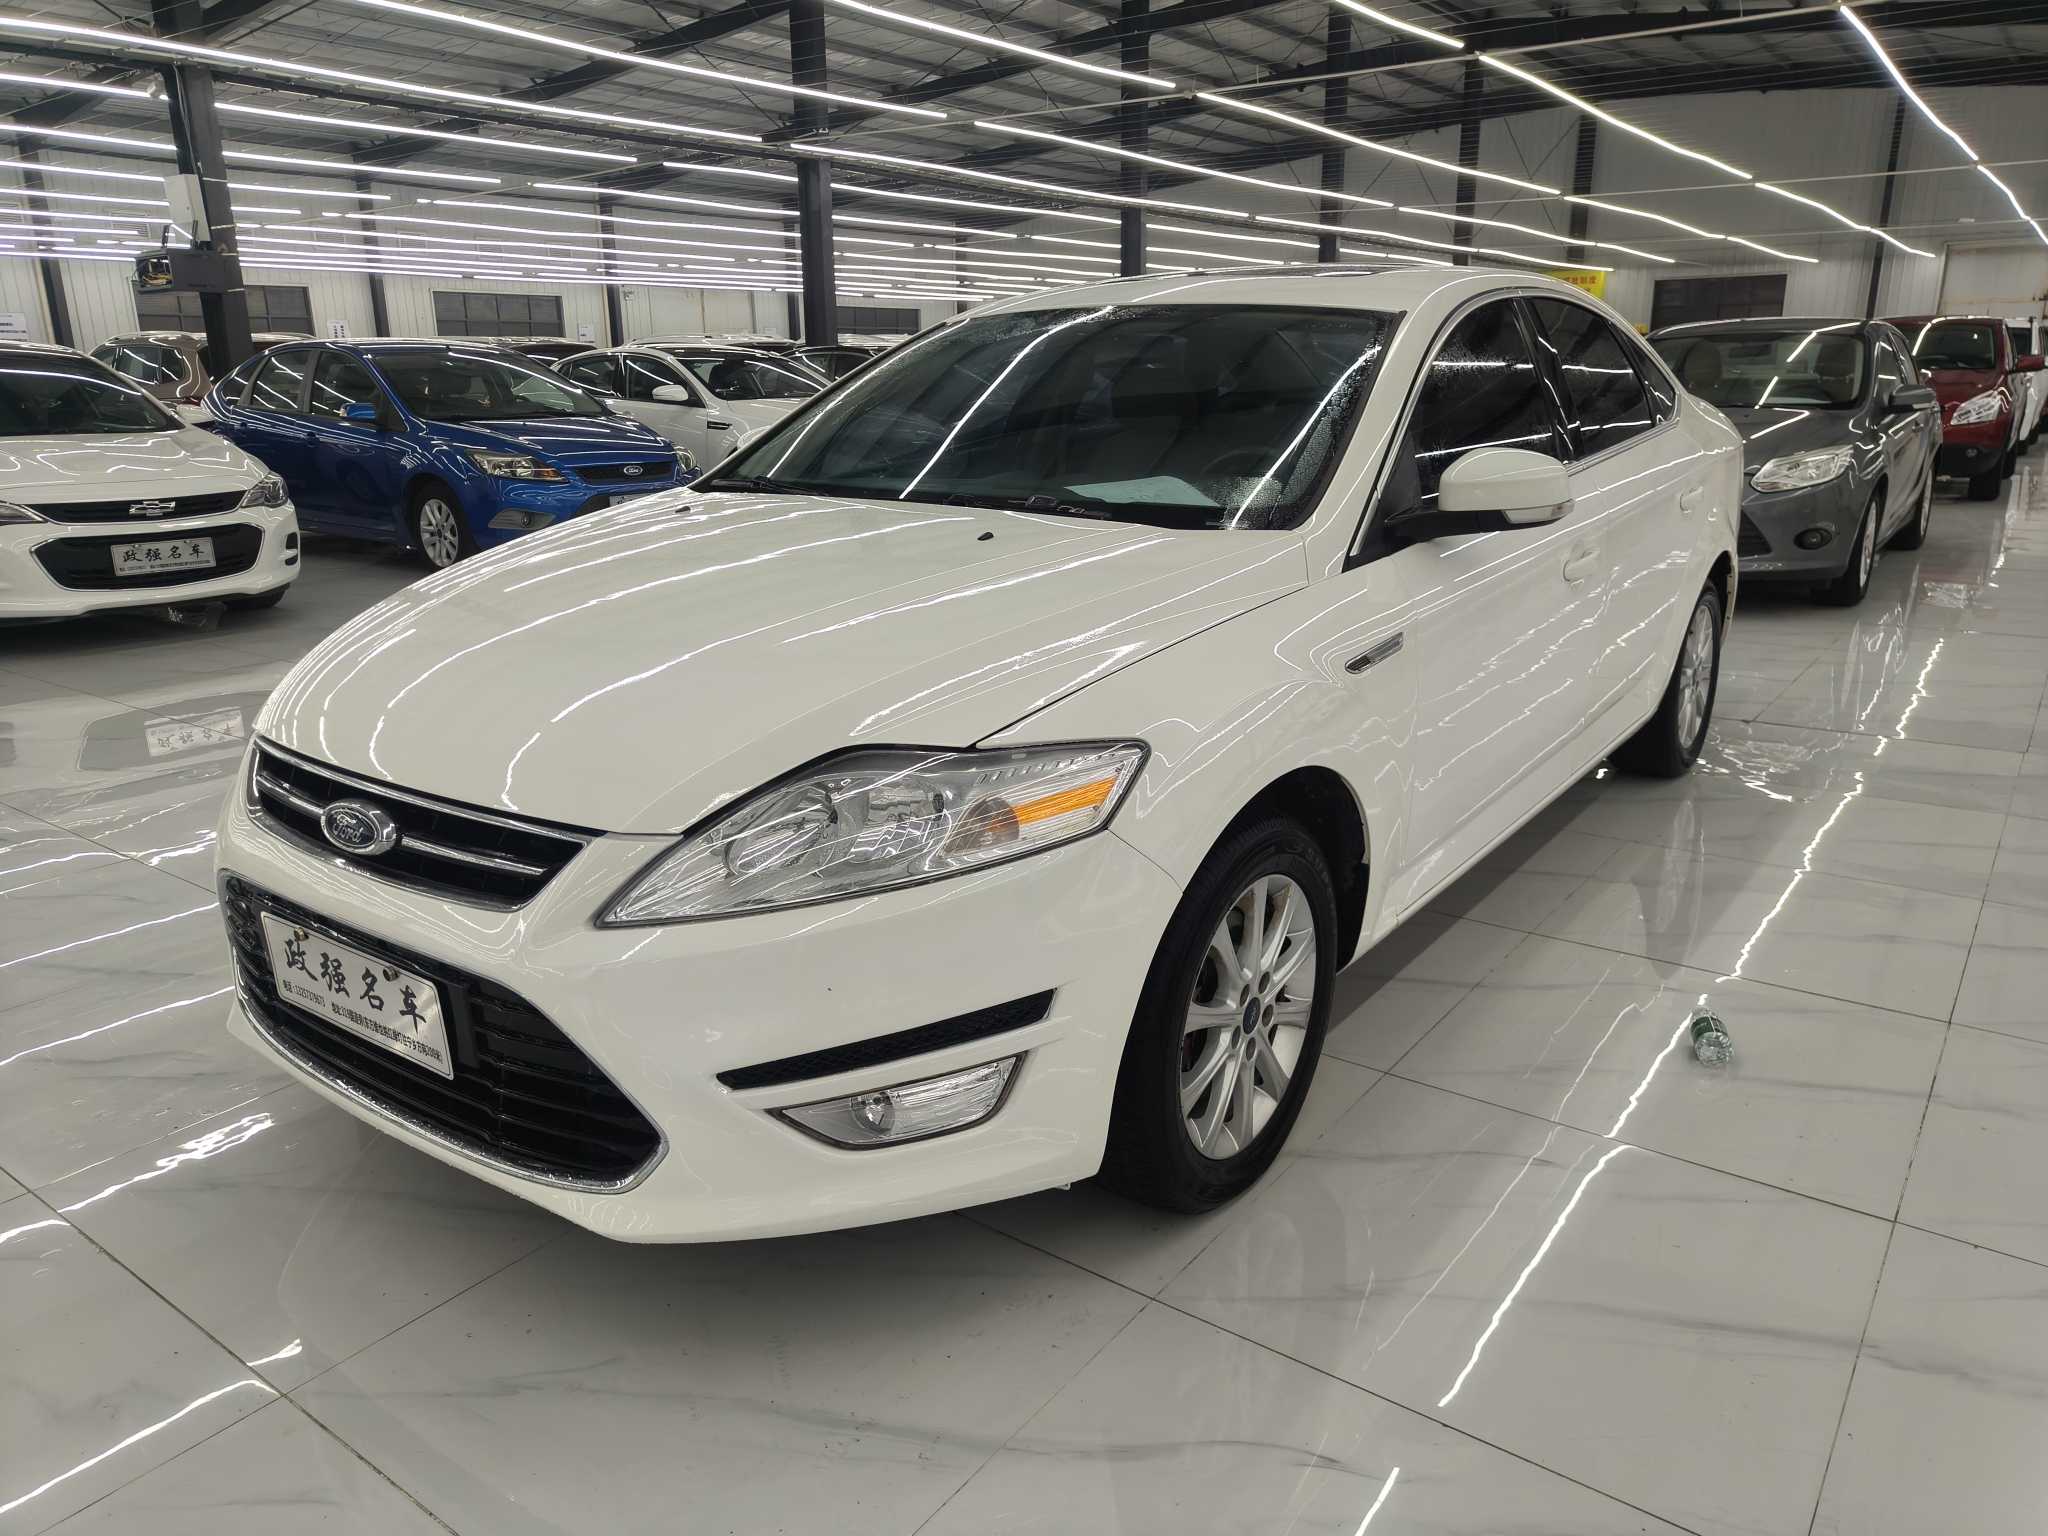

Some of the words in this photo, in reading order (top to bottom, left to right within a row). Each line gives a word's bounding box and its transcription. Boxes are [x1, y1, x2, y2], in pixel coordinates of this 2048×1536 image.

[123, 543, 204, 562] 政强名车
[332, 813, 364, 843] Ford
[284, 936, 427, 1034] 政强名车
